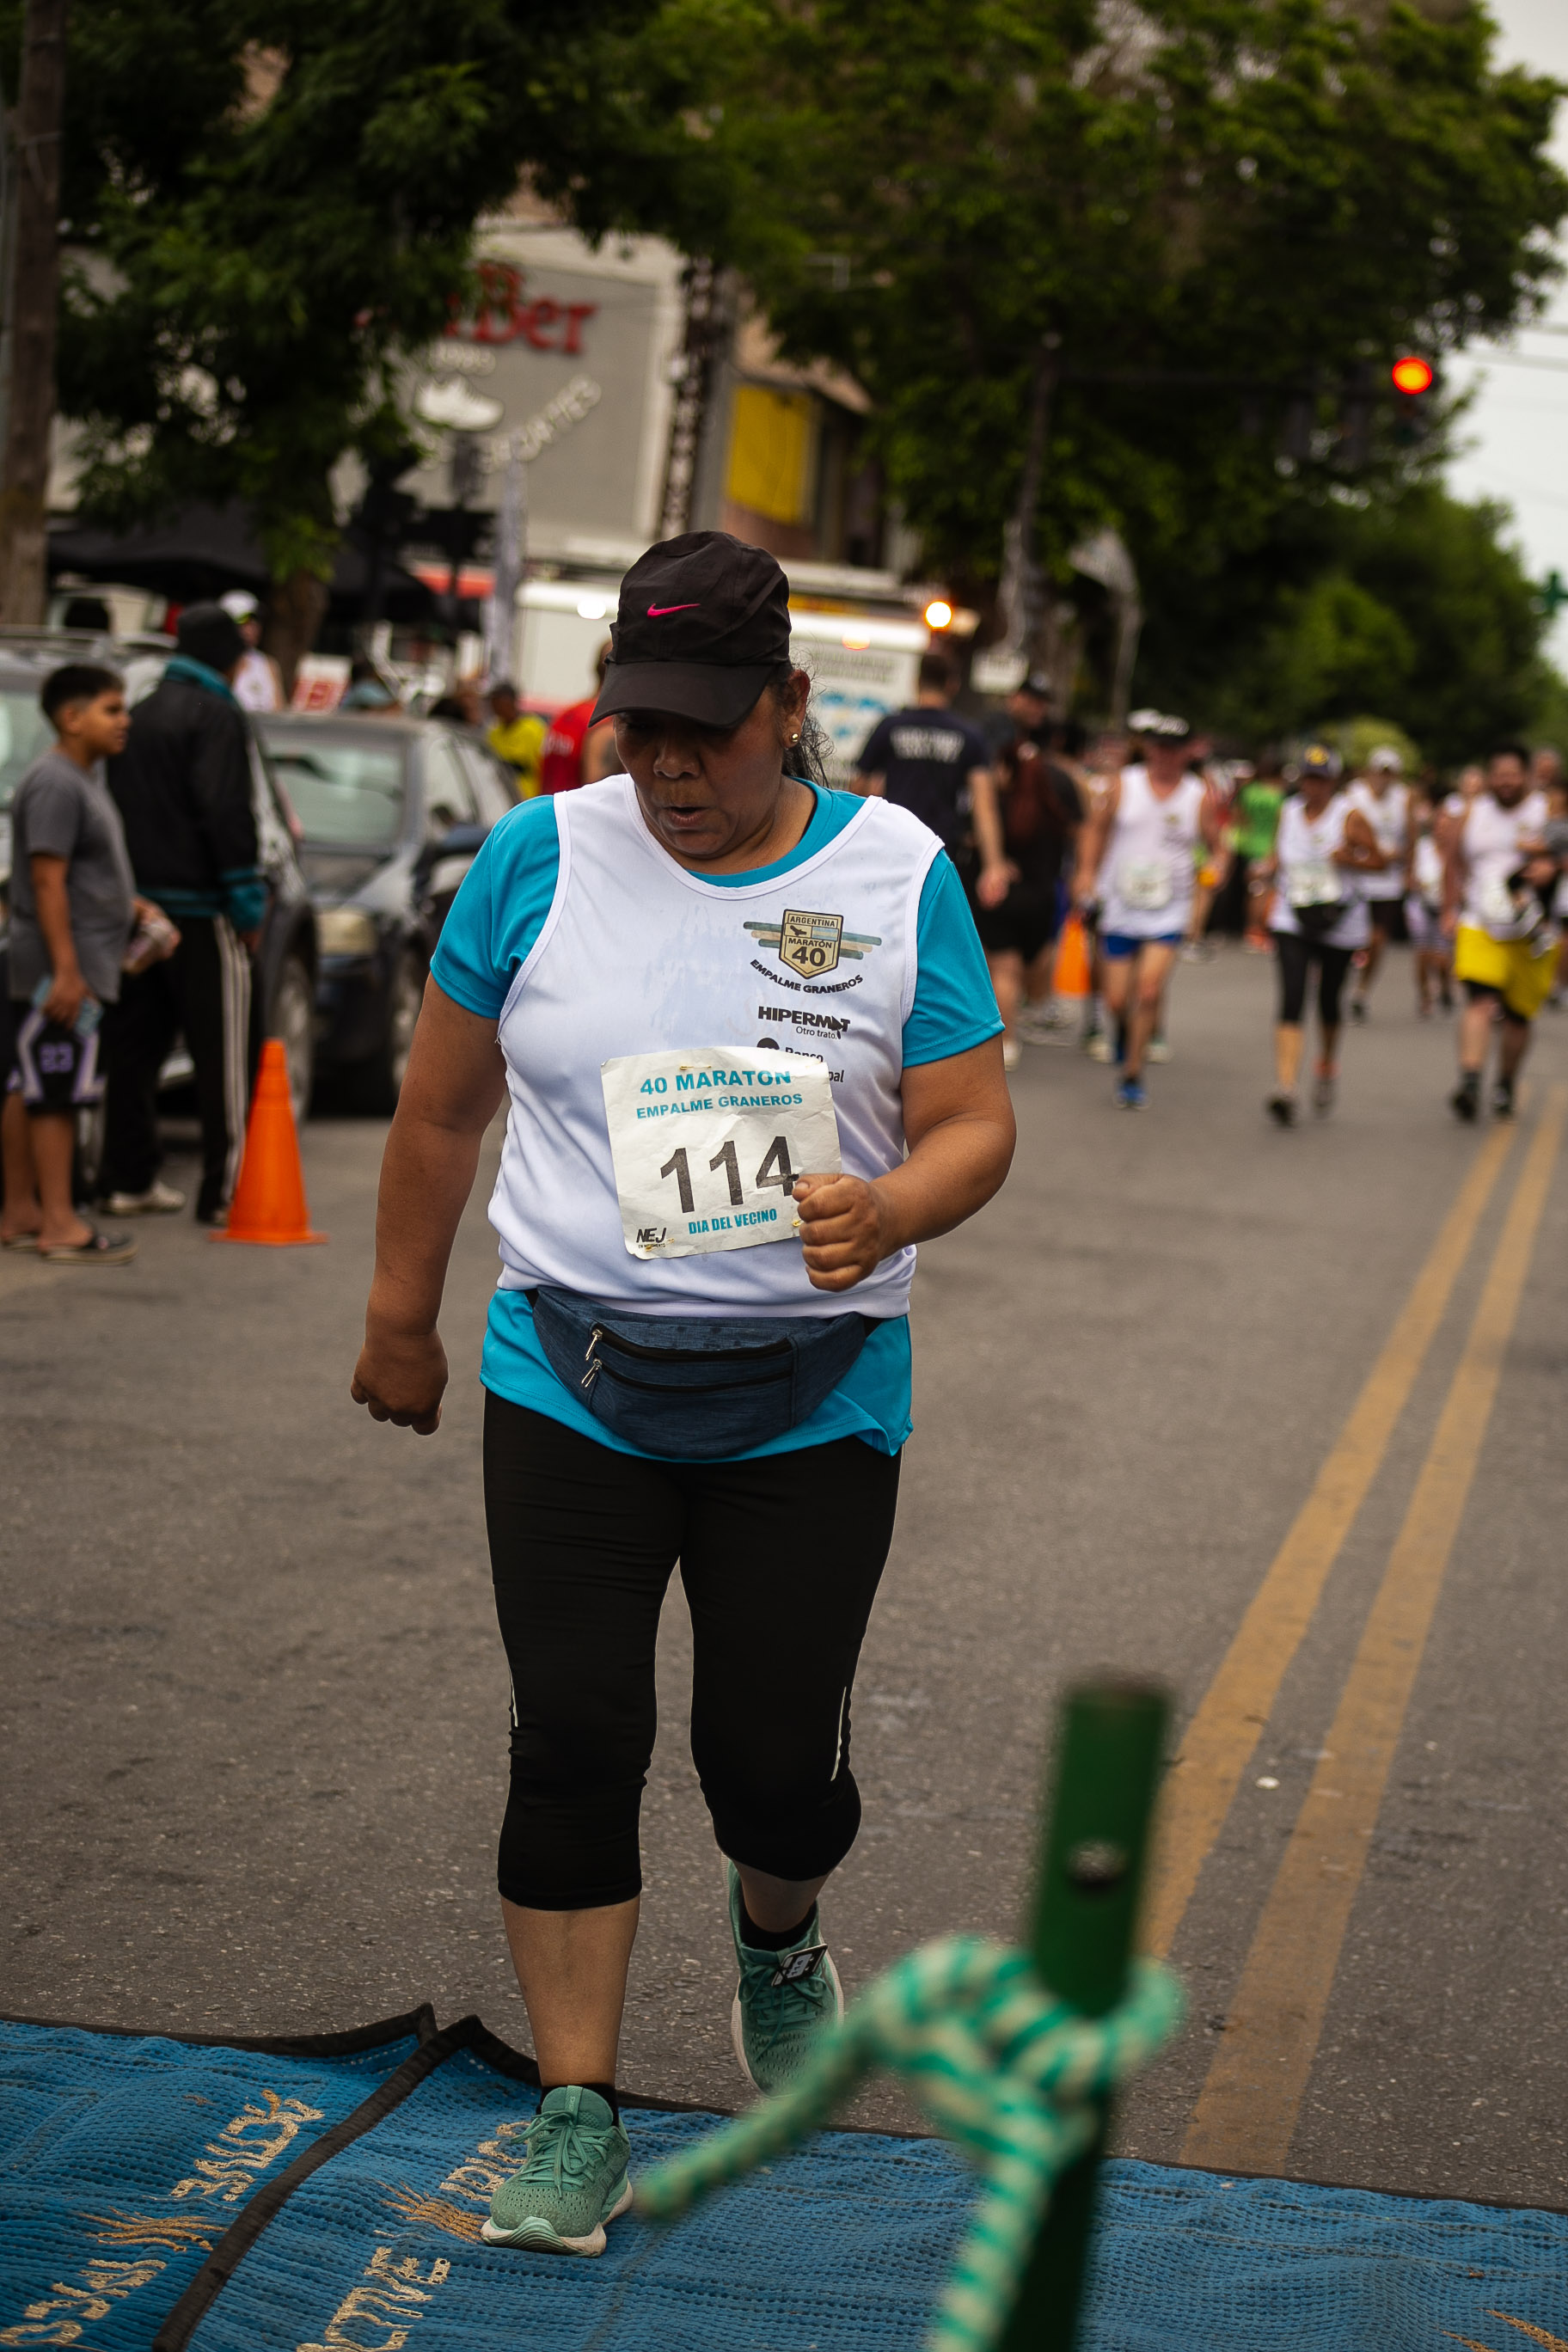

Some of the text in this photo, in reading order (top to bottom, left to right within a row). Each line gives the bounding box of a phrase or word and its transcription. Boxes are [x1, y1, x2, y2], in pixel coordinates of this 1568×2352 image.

[790, 916, 836, 928] ARGENTINA
[787, 937, 832, 949] MARATÓN
[792, 946, 826, 967] 40
[750, 959, 864, 994] EMPALME GRANEROS
[796, 1026, 815, 1036] Otro
[640, 1069, 792, 1095] 40 MARATON
[636, 1093, 803, 1119] EMPALME GRANEROS
[660, 1136, 799, 1214] 114
[688, 1208, 777, 1234] DIA DEL VECINO
[636, 1227, 667, 1243] NEJ
